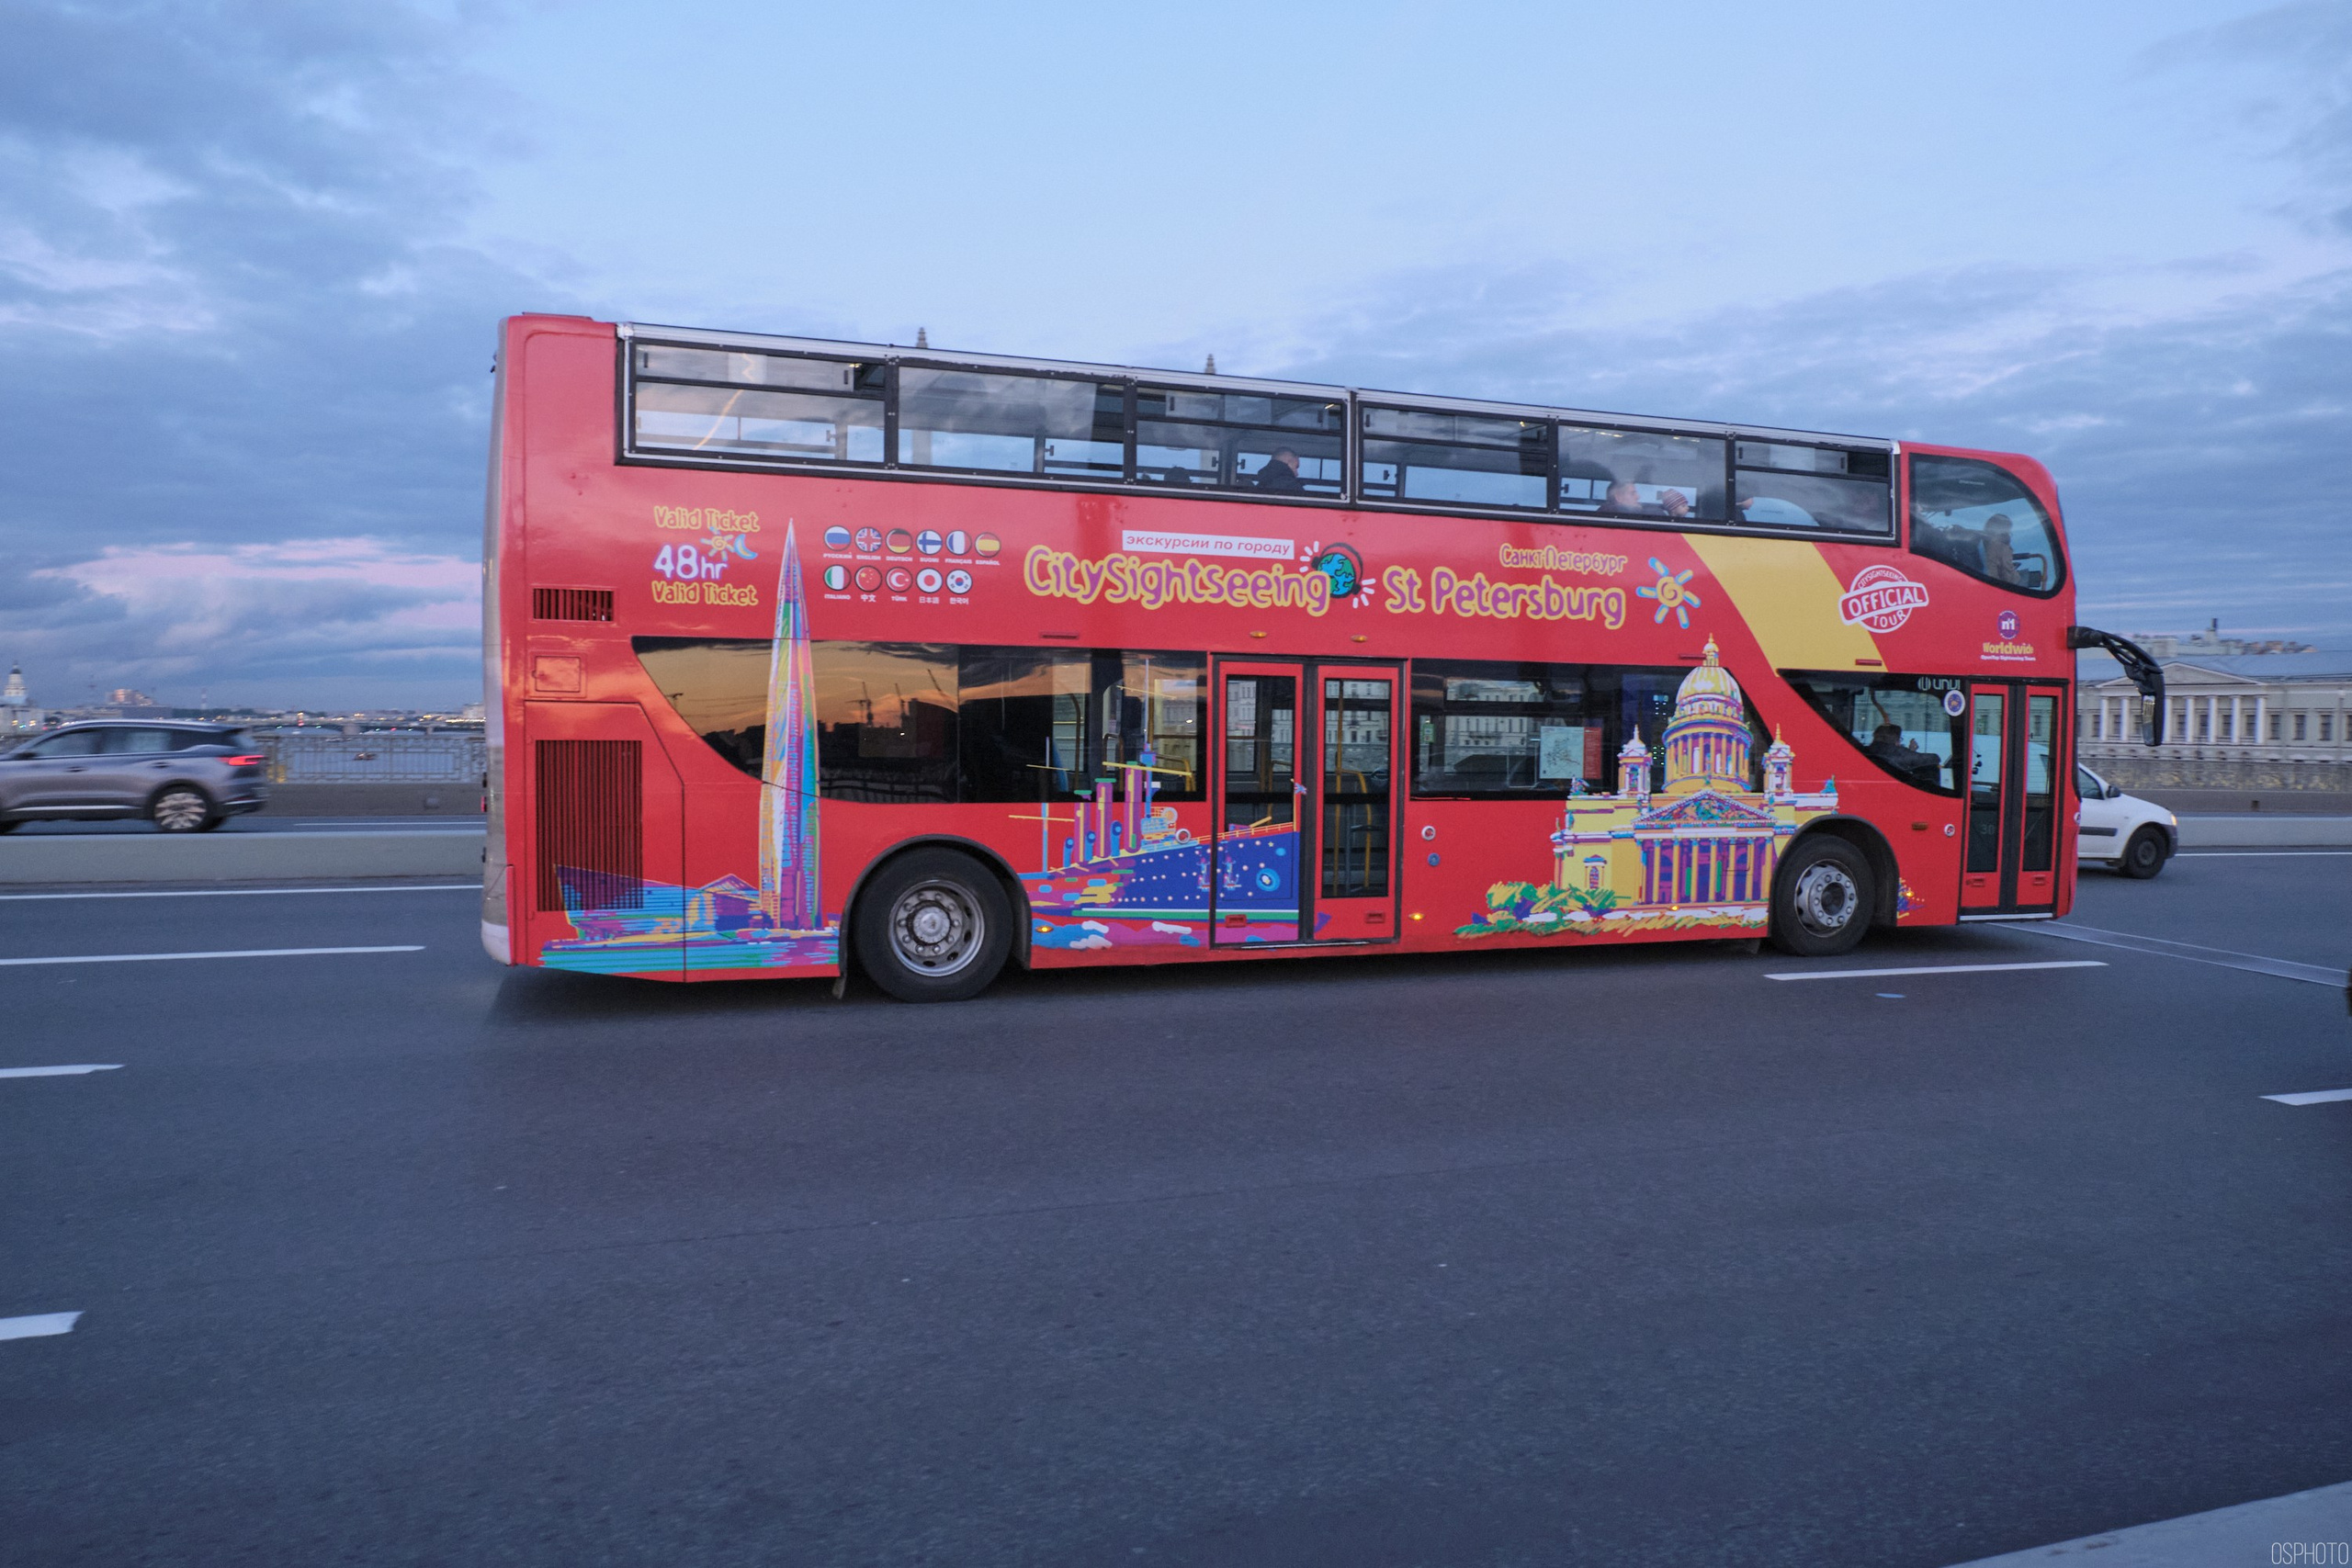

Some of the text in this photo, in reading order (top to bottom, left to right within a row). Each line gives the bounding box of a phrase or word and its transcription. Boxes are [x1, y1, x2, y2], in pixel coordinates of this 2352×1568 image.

[653, 505, 761, 533] Valid Ticket
[1126, 536, 1291, 556] экскурсии по городу
[653, 544, 729, 580] 48hr
[651, 580, 759, 606] Valid Ticket
[1383, 566, 1626, 629] St Petersburg
[1848, 587, 1924, 617] OFFICIAL
[1873, 609, 1906, 628] TOUR
[1983, 642, 2034, 655] Worldwide
